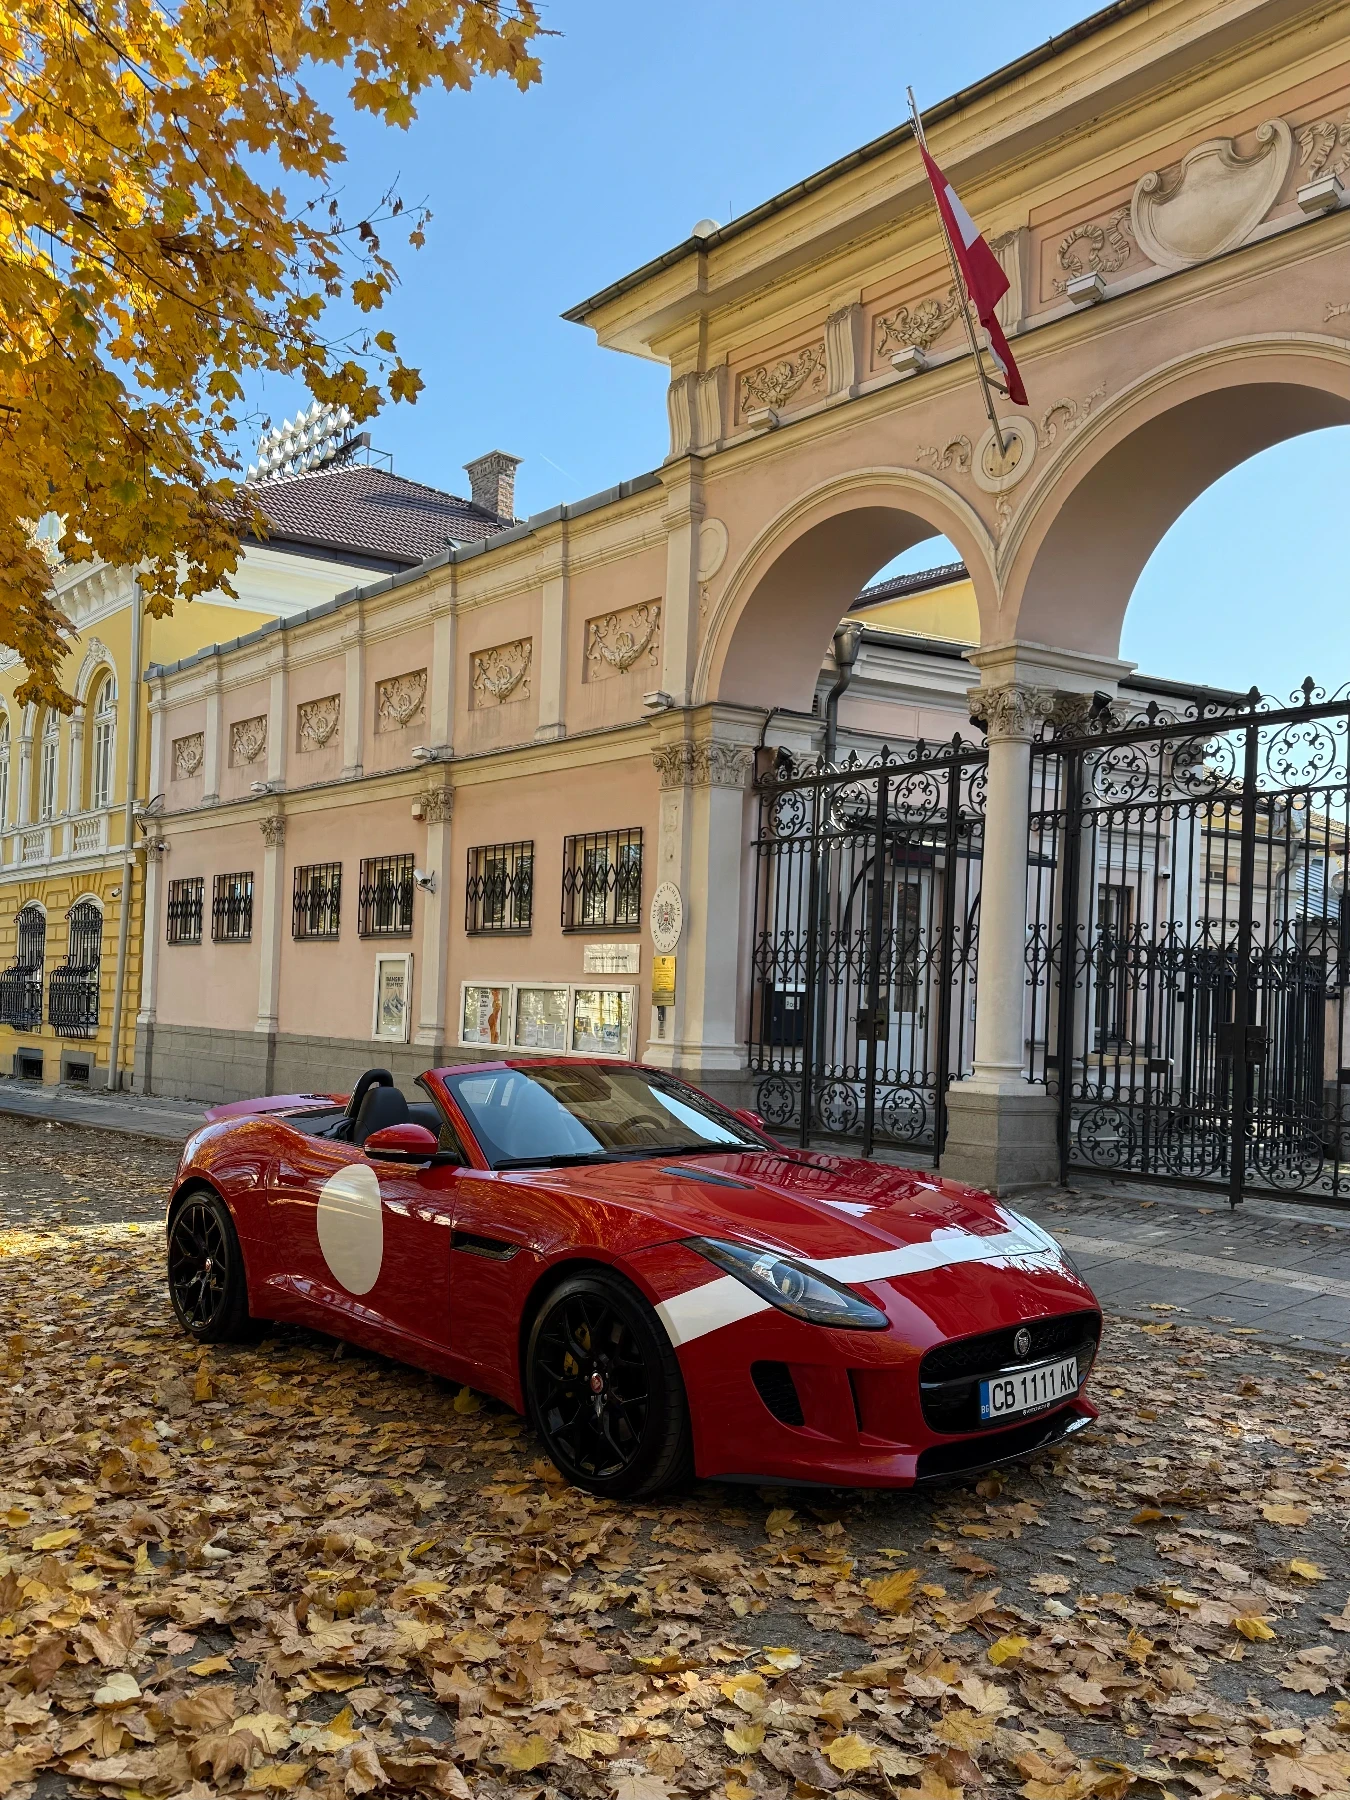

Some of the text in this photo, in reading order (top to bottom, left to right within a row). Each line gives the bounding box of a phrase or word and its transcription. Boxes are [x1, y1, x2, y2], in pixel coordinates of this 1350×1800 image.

[992, 1380, 1016, 1411] CB
[1021, 1369, 1056, 1404] 1111
[1060, 1361, 1076, 1393] AK
[981, 1404, 990, 1414] BG
